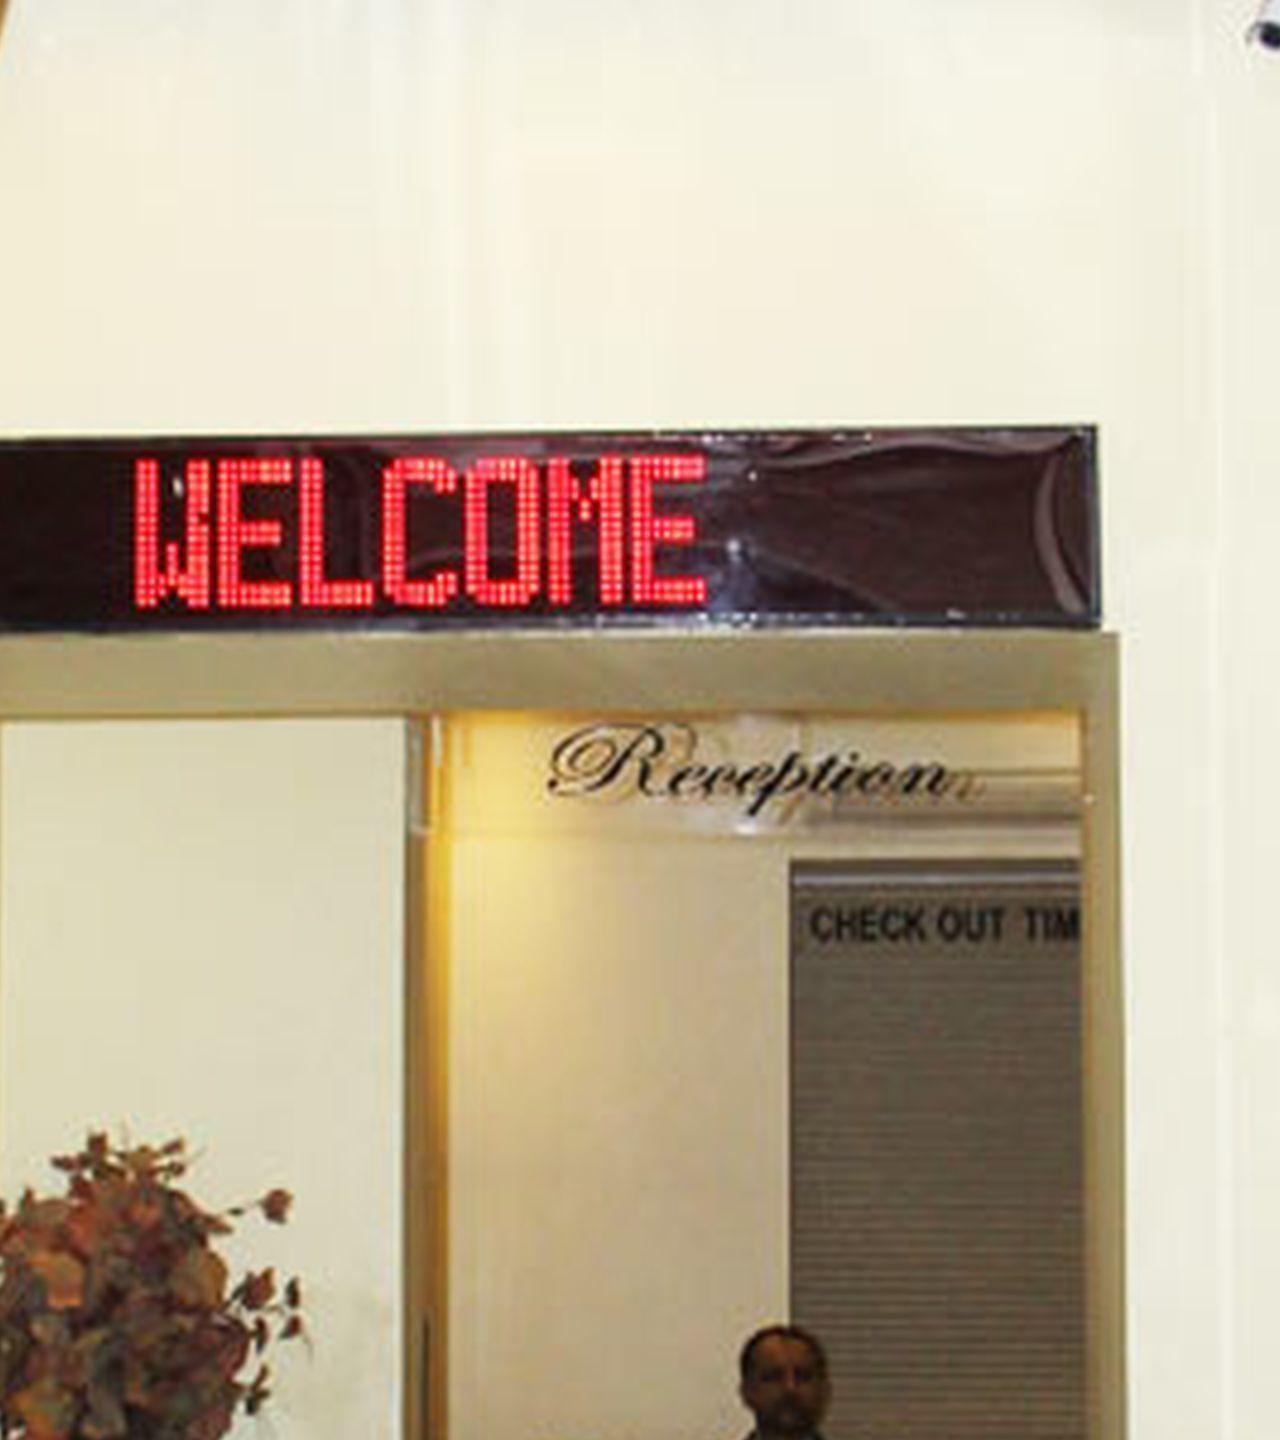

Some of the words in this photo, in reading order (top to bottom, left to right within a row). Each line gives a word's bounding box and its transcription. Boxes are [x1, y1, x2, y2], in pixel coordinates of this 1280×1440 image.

[135, 455, 706, 608] WELCOME
[547, 721, 948, 817] Reception
[810, 906, 926, 943] CHECK
[937, 906, 1005, 943] OUT
